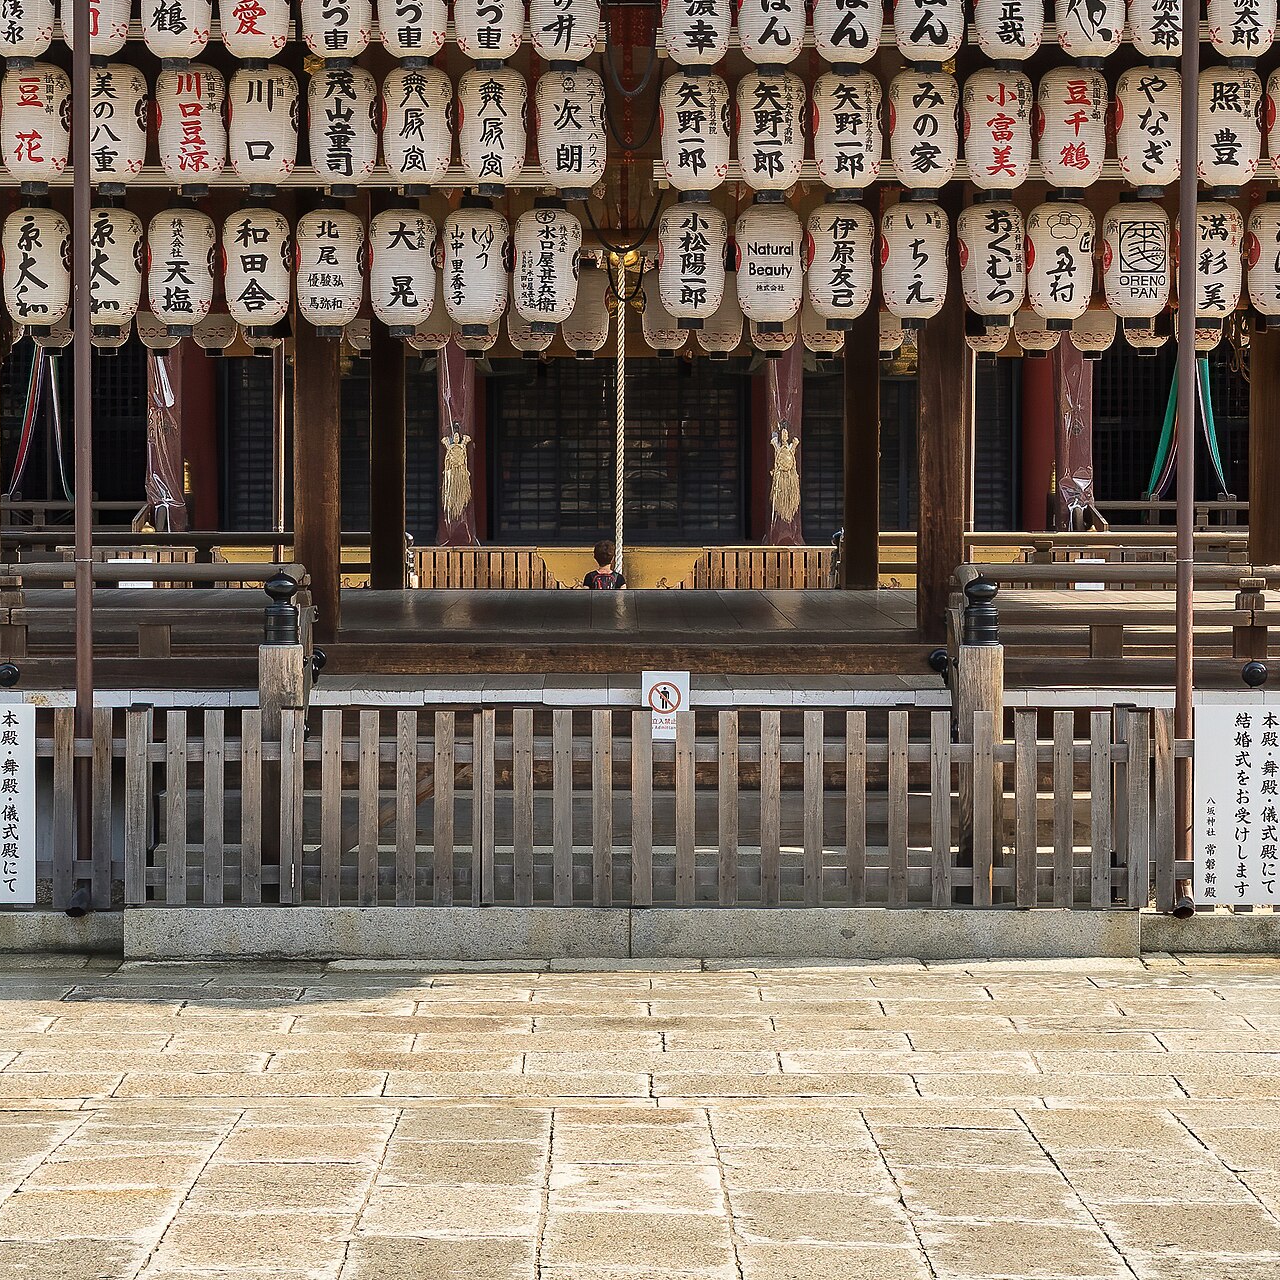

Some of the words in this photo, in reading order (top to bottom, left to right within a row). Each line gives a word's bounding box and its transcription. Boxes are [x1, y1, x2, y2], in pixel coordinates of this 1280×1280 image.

[13, 76, 44, 163] 豆花
[91, 72, 121, 173] 美の八重
[176, 72, 210, 172] 川口豆涼
[245, 79, 275, 162] 川口
[324, 71, 357, 176] 茂山童司
[553, 98, 583, 173] 次朗
[586, 78, 598, 168] ステーキハウス
[675, 81, 707, 177] 矢野一郎
[751, 80, 786, 179] 矢野一郎
[831, 82, 865, 180] 矢野一郎
[910, 81, 944, 172] みの家
[986, 83, 1018, 177] 小富美
[1059, 80, 1092, 170] 豆千鶴
[1136, 75, 1171, 173] やなぎ
[1209, 81, 1243, 167] 照豊
[13, 215, 48, 317] 京大和
[170, 218, 184, 257] 株式会社
[234, 219, 276, 313] 和田舎
[316, 220, 339, 265] 北尾
[386, 222, 419, 308] 大晃
[450, 224, 467, 306] 山中里香子
[472, 224, 495, 270] ゆう
[535, 225, 557, 313] 水口屋甚兵衛
[678, 212, 711, 310] 小松陽一郎
[747, 241, 794, 257] Natural
[749, 261, 793, 278] Beauty
[905, 212, 935, 305] いちえ
[984, 210, 1014, 304] おくむら
[1120, 275, 1166, 287] ORENO
[1198, 214, 1228, 311] 満彩美
[162, 260, 195, 313] 天塩
[756, 284, 785, 292] 株式会社
[1130, 287, 1158, 299] PAN
[1, 710, 19, 893] 本殿・舞殿・儀式殿にて
[1206, 796, 1216, 837] 八坂神社
[1234, 712, 1252, 898] 結婚式をお受けします
[1261, 711, 1279, 894] 本殿・舞殿・儀式殿にて
[1204, 843, 1217, 898] 常磐新殿
